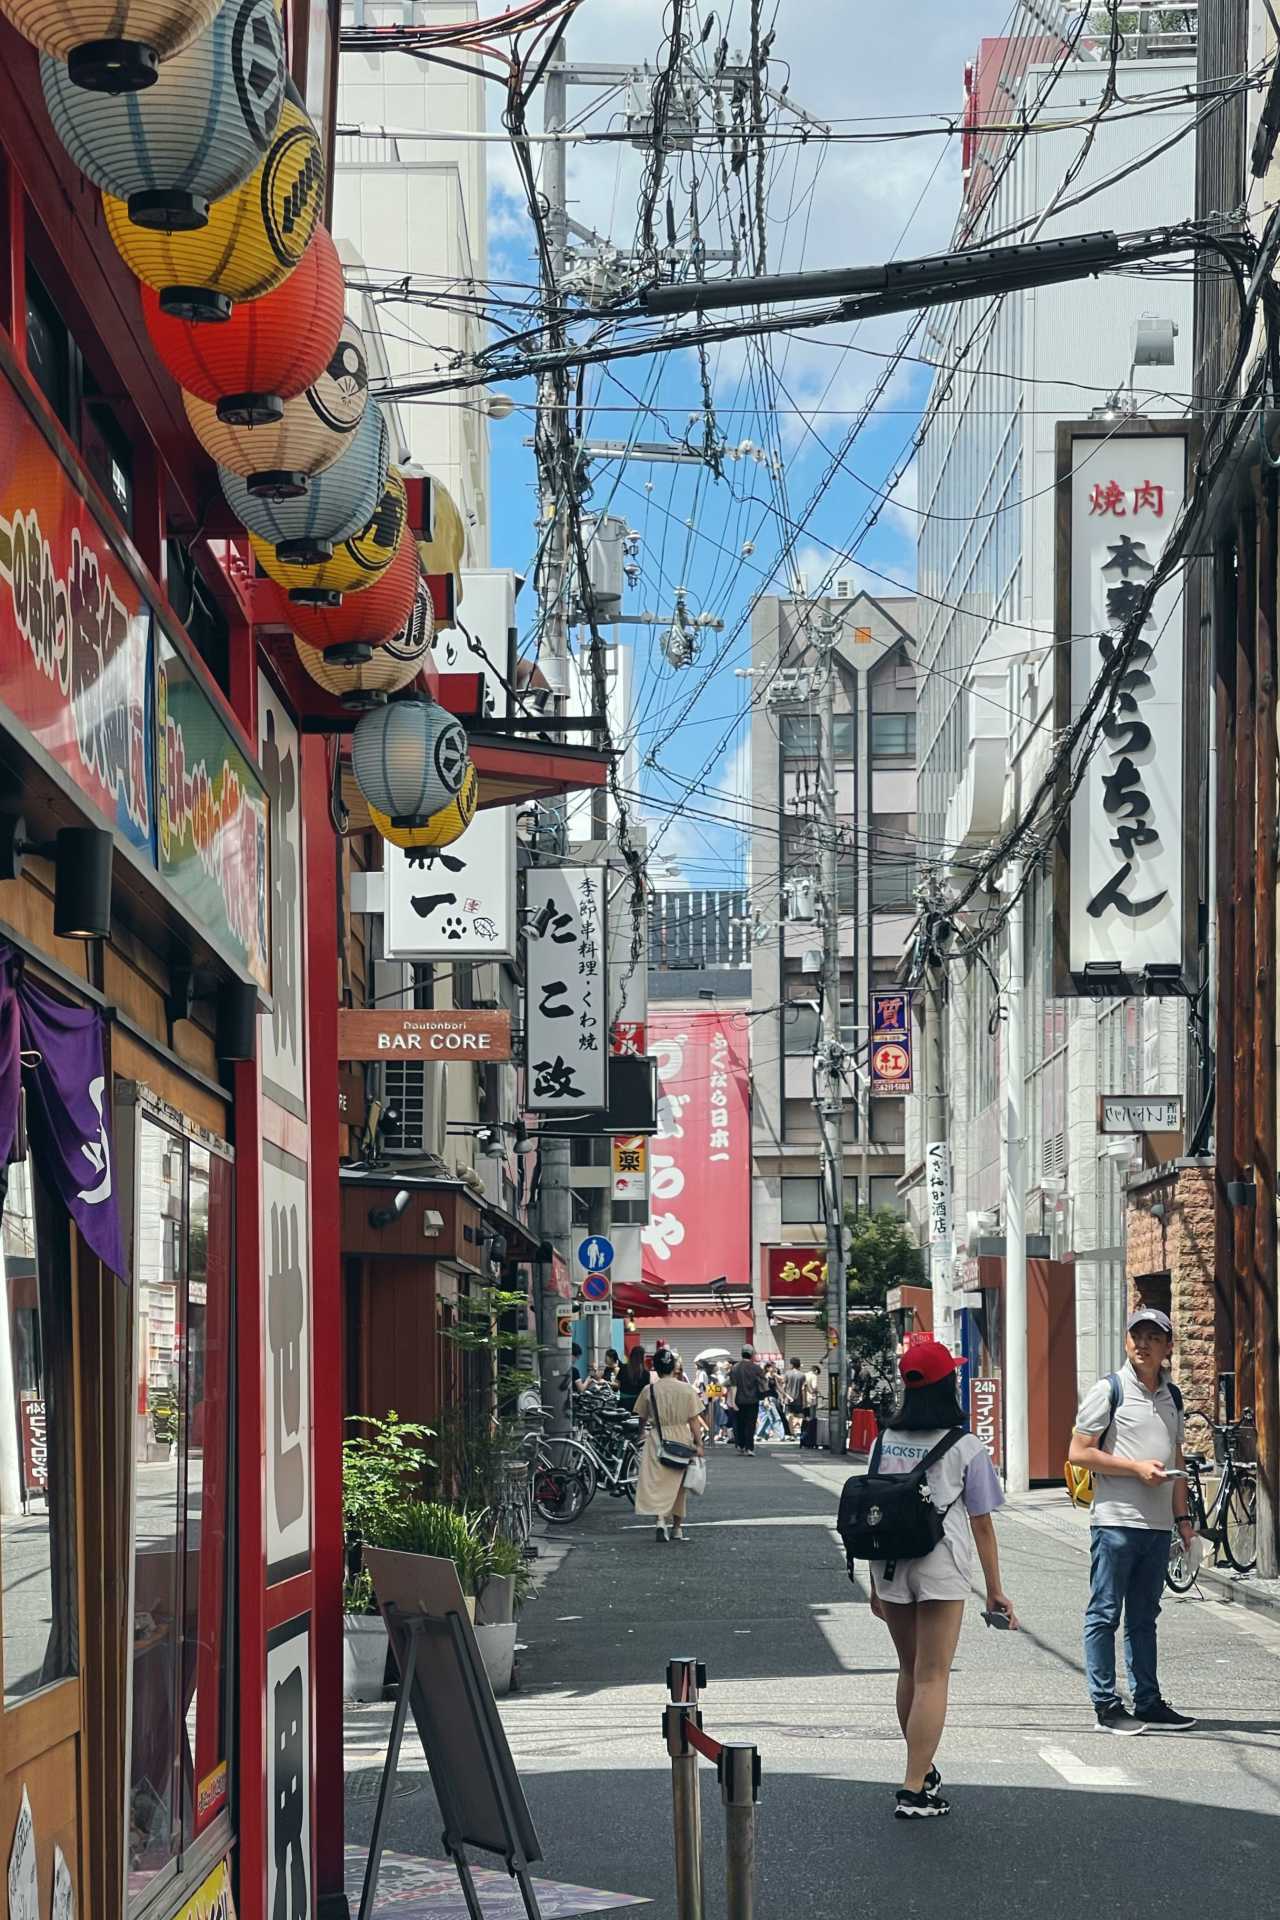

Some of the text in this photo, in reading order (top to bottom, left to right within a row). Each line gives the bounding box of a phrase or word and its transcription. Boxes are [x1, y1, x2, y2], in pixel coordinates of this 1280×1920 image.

[1087, 480, 1165, 518] 焼肉
[533, 898, 586, 1098] たこ政
[577, 877, 599, 1051] 季節串料理・くわ焼
[377, 1033, 492, 1050] BAR CORE
[709, 1032, 730, 1162] ふぐなら日本一
[974, 1381, 996, 1393] 24h
